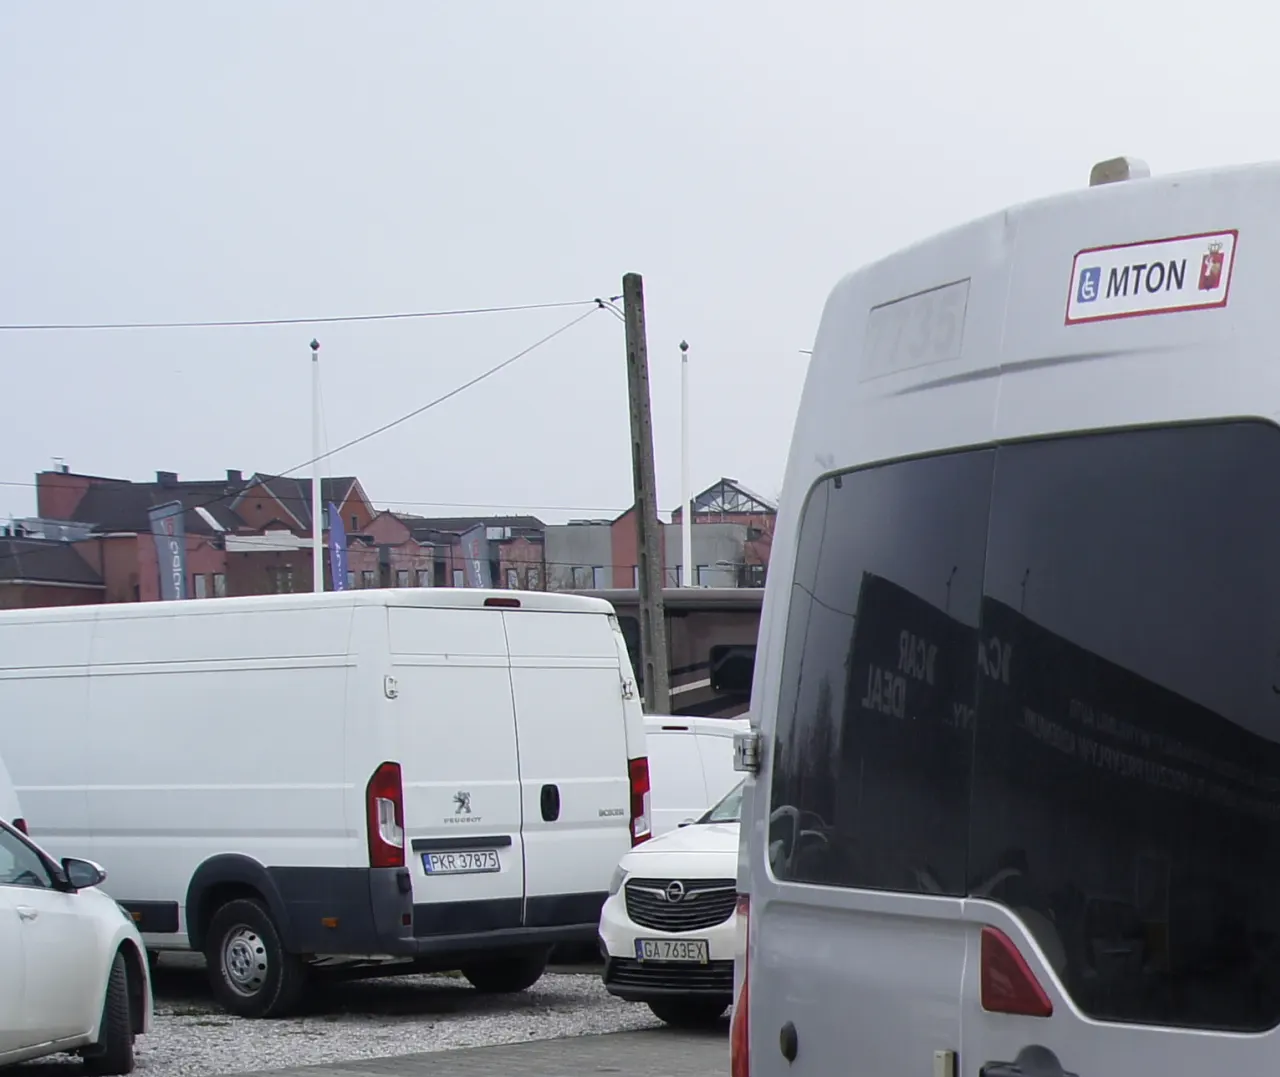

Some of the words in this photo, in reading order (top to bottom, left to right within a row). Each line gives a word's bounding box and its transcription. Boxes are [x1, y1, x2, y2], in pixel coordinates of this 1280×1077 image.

[1106, 259, 1187, 298] MTON
[431, 854, 456, 870] PKR
[458, 852, 497, 869] 37875
[644, 942, 660, 958] GA
[664, 942, 704, 959] 763EX
